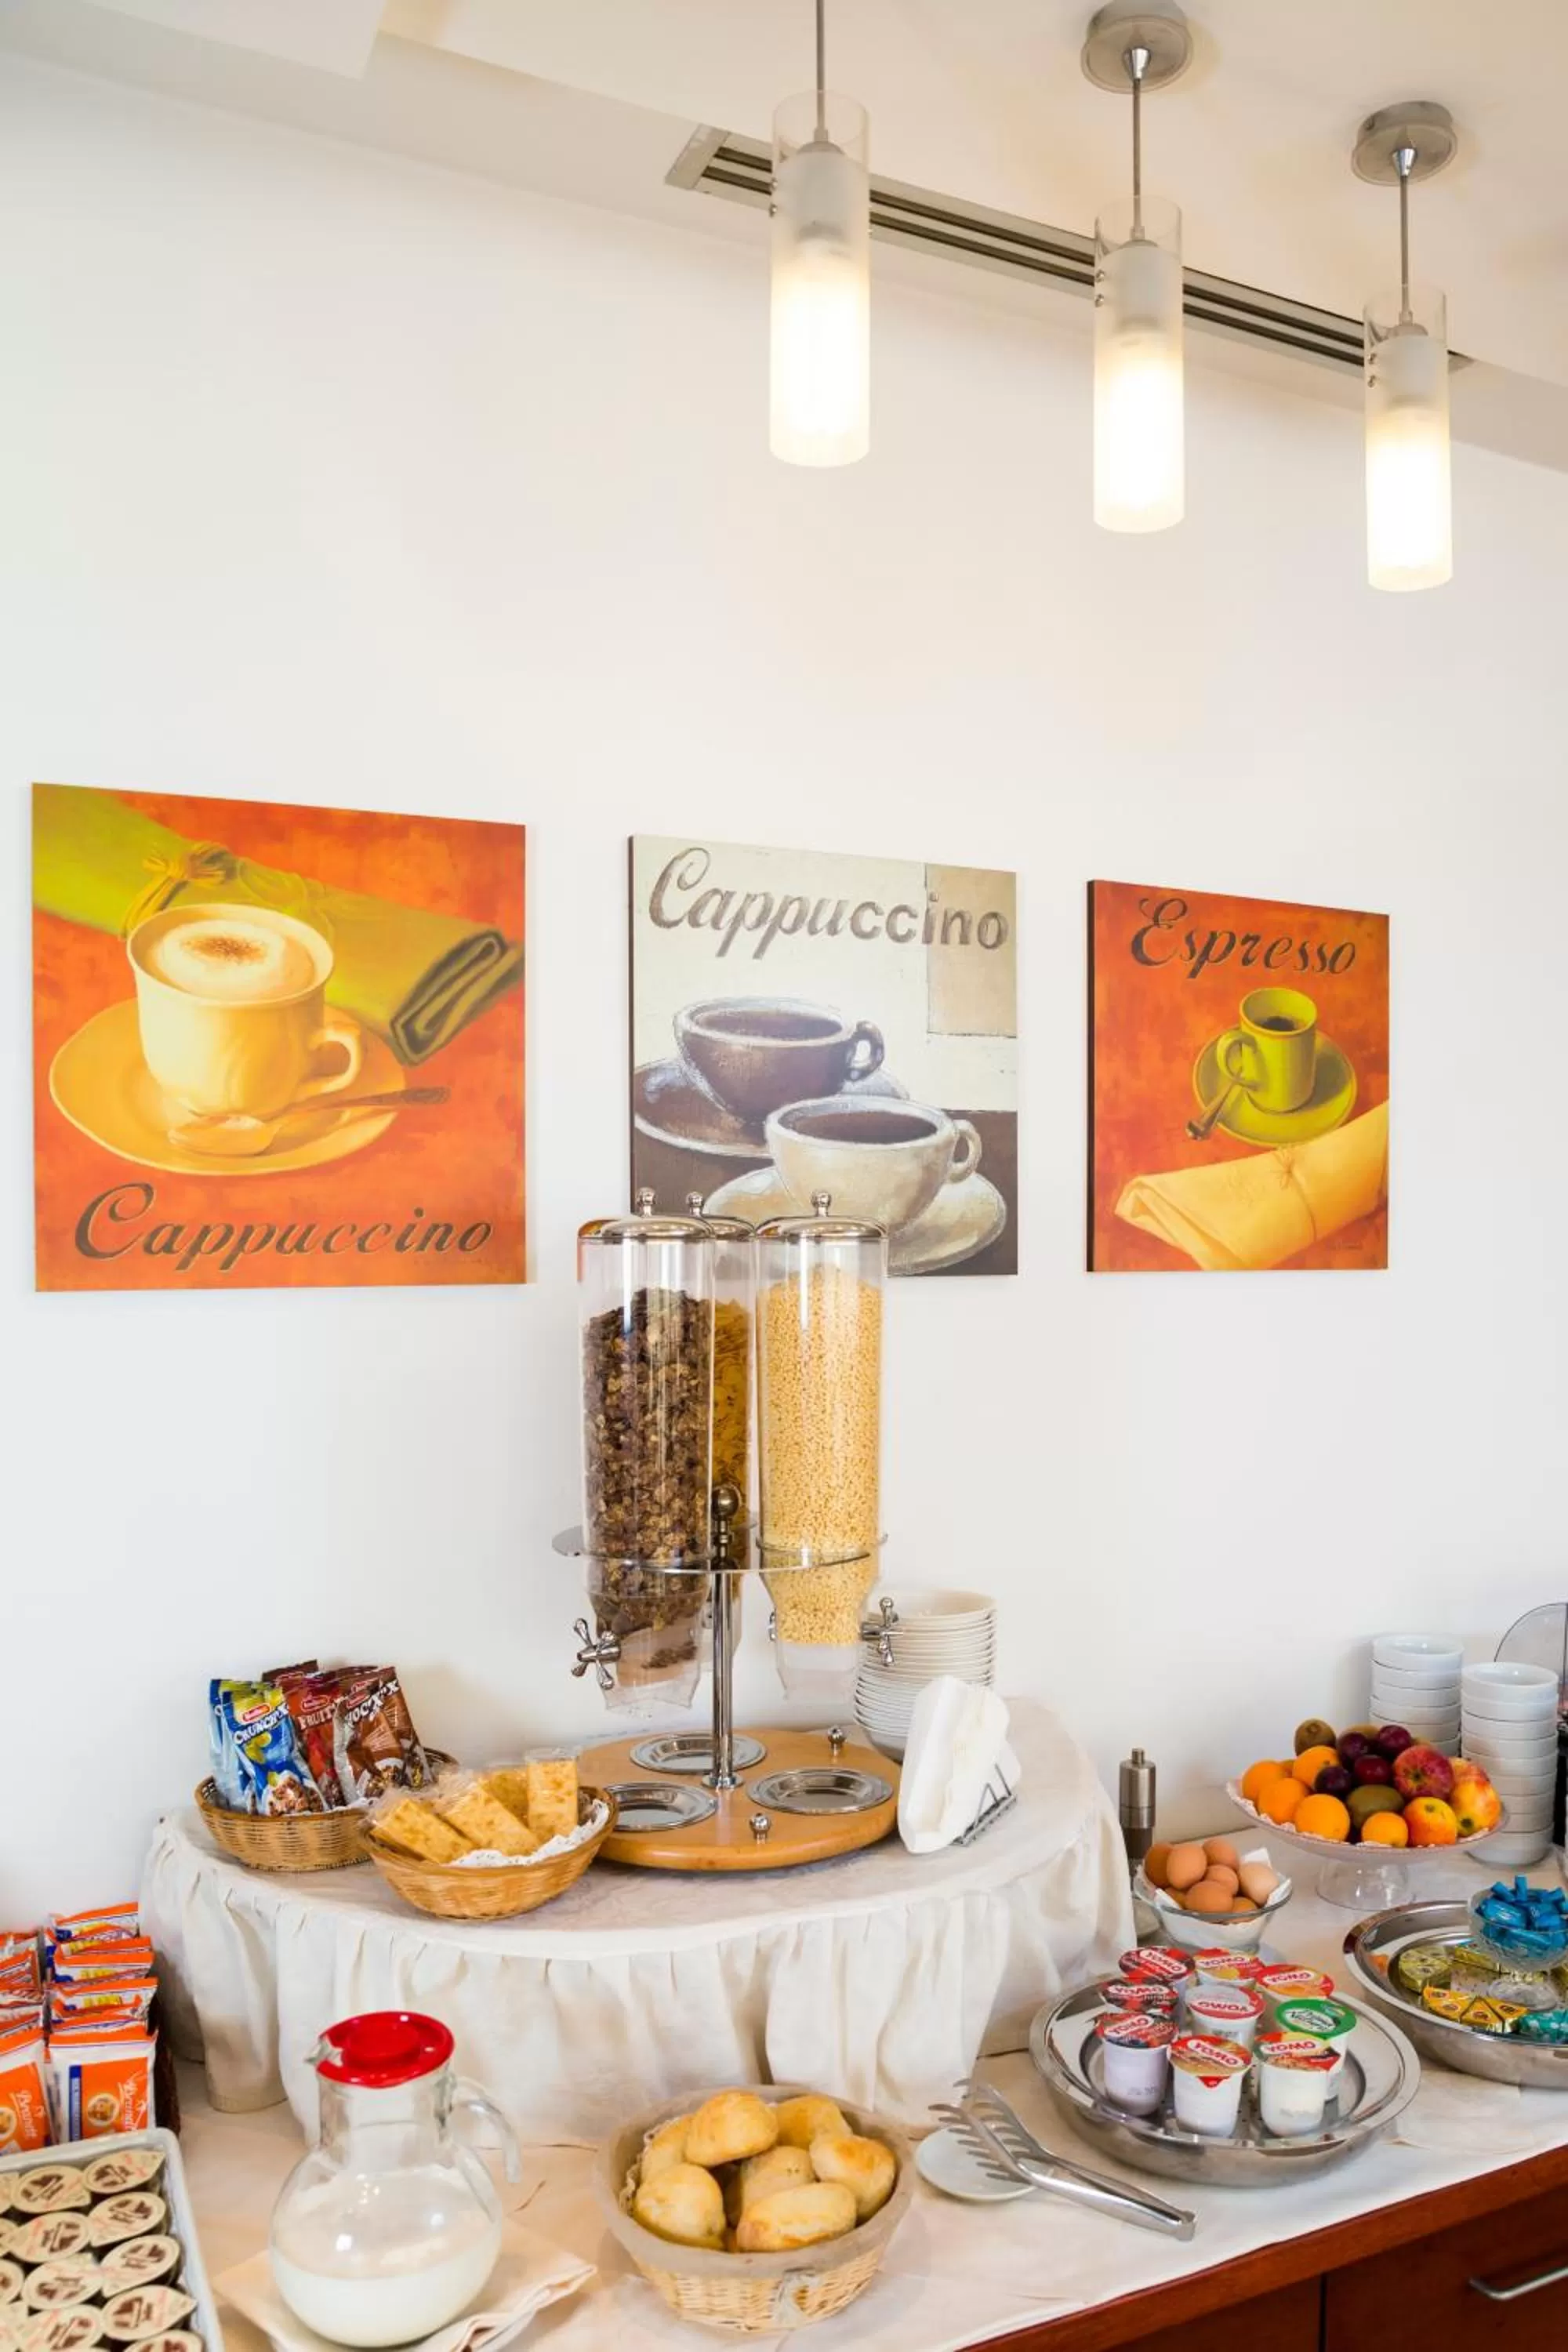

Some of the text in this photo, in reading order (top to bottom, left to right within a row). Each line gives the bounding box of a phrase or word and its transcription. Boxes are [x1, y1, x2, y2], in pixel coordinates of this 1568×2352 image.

[649, 847, 1008, 960] Cappuccino
[1131, 898, 1356, 978] Espresso
[74, 1182, 493, 1271] Cappuccino
[1194, 2041, 1238, 2066] YOMO
[1266, 2040, 1316, 2052] YOMO
